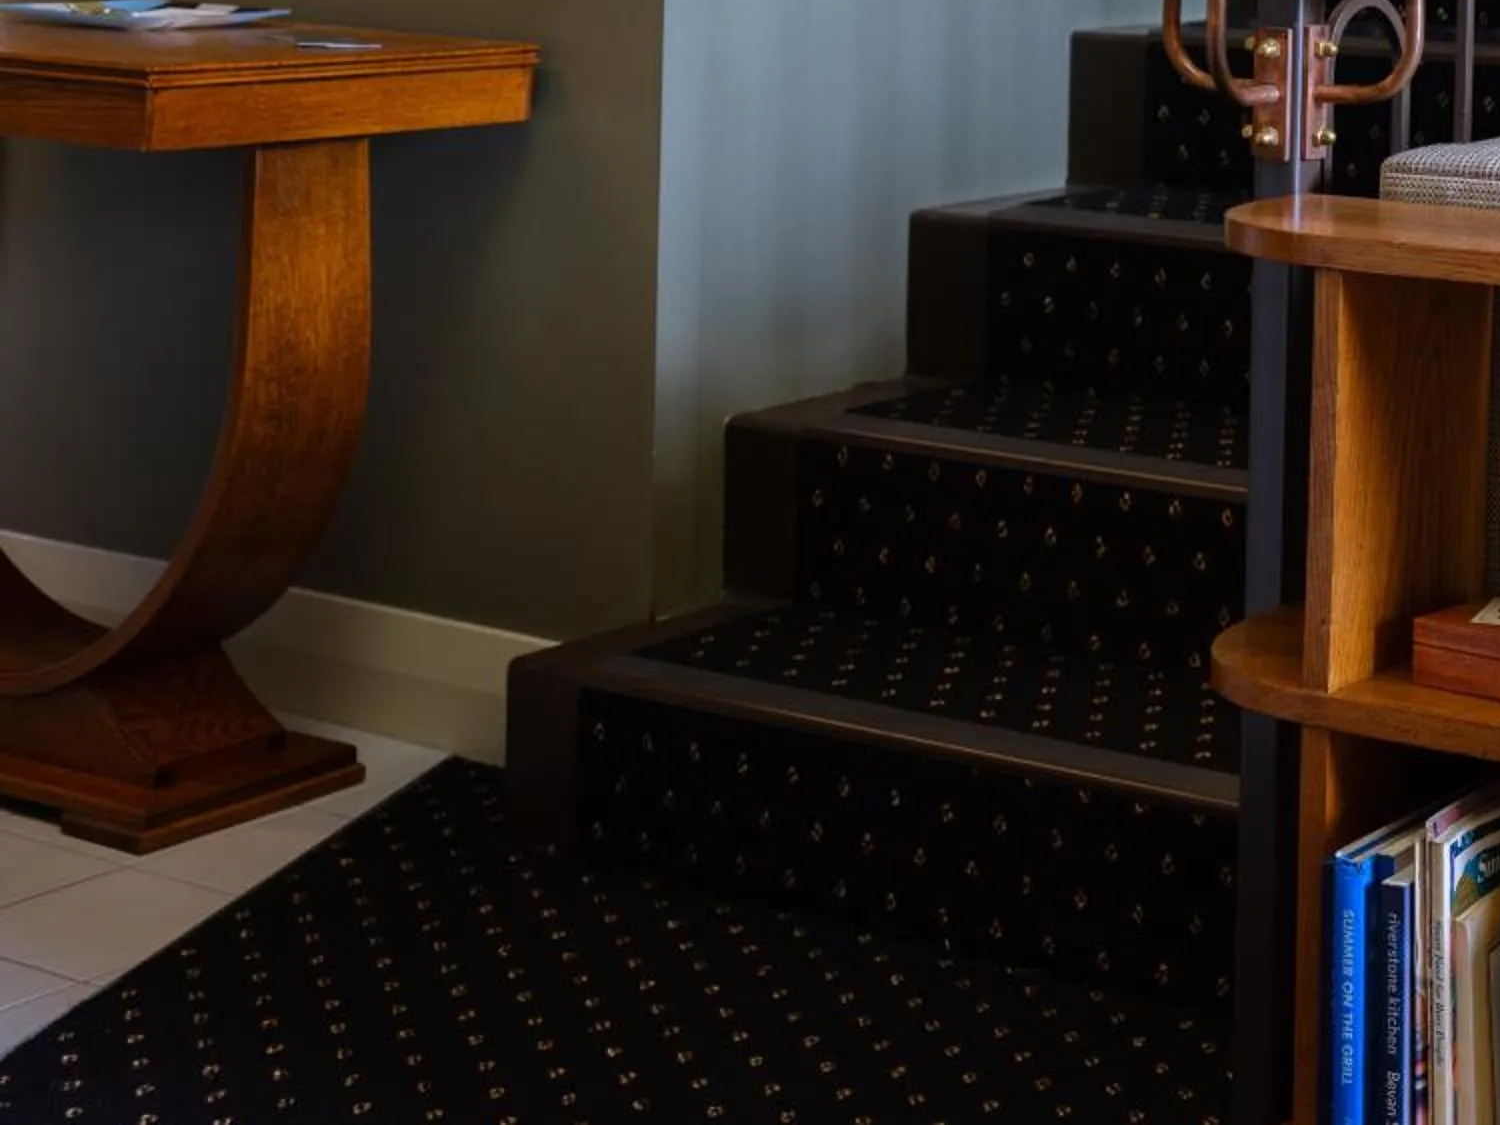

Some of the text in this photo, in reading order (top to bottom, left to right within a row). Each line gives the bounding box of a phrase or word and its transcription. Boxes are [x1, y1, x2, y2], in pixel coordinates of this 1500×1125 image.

[1384, 912, 1400, 993] riverstone
[1340, 909, 1355, 1086] SUMMER ON THE GRILL
[1384, 995, 1400, 1055] kitchen
[1385, 1070, 1400, 1115] Bevan
